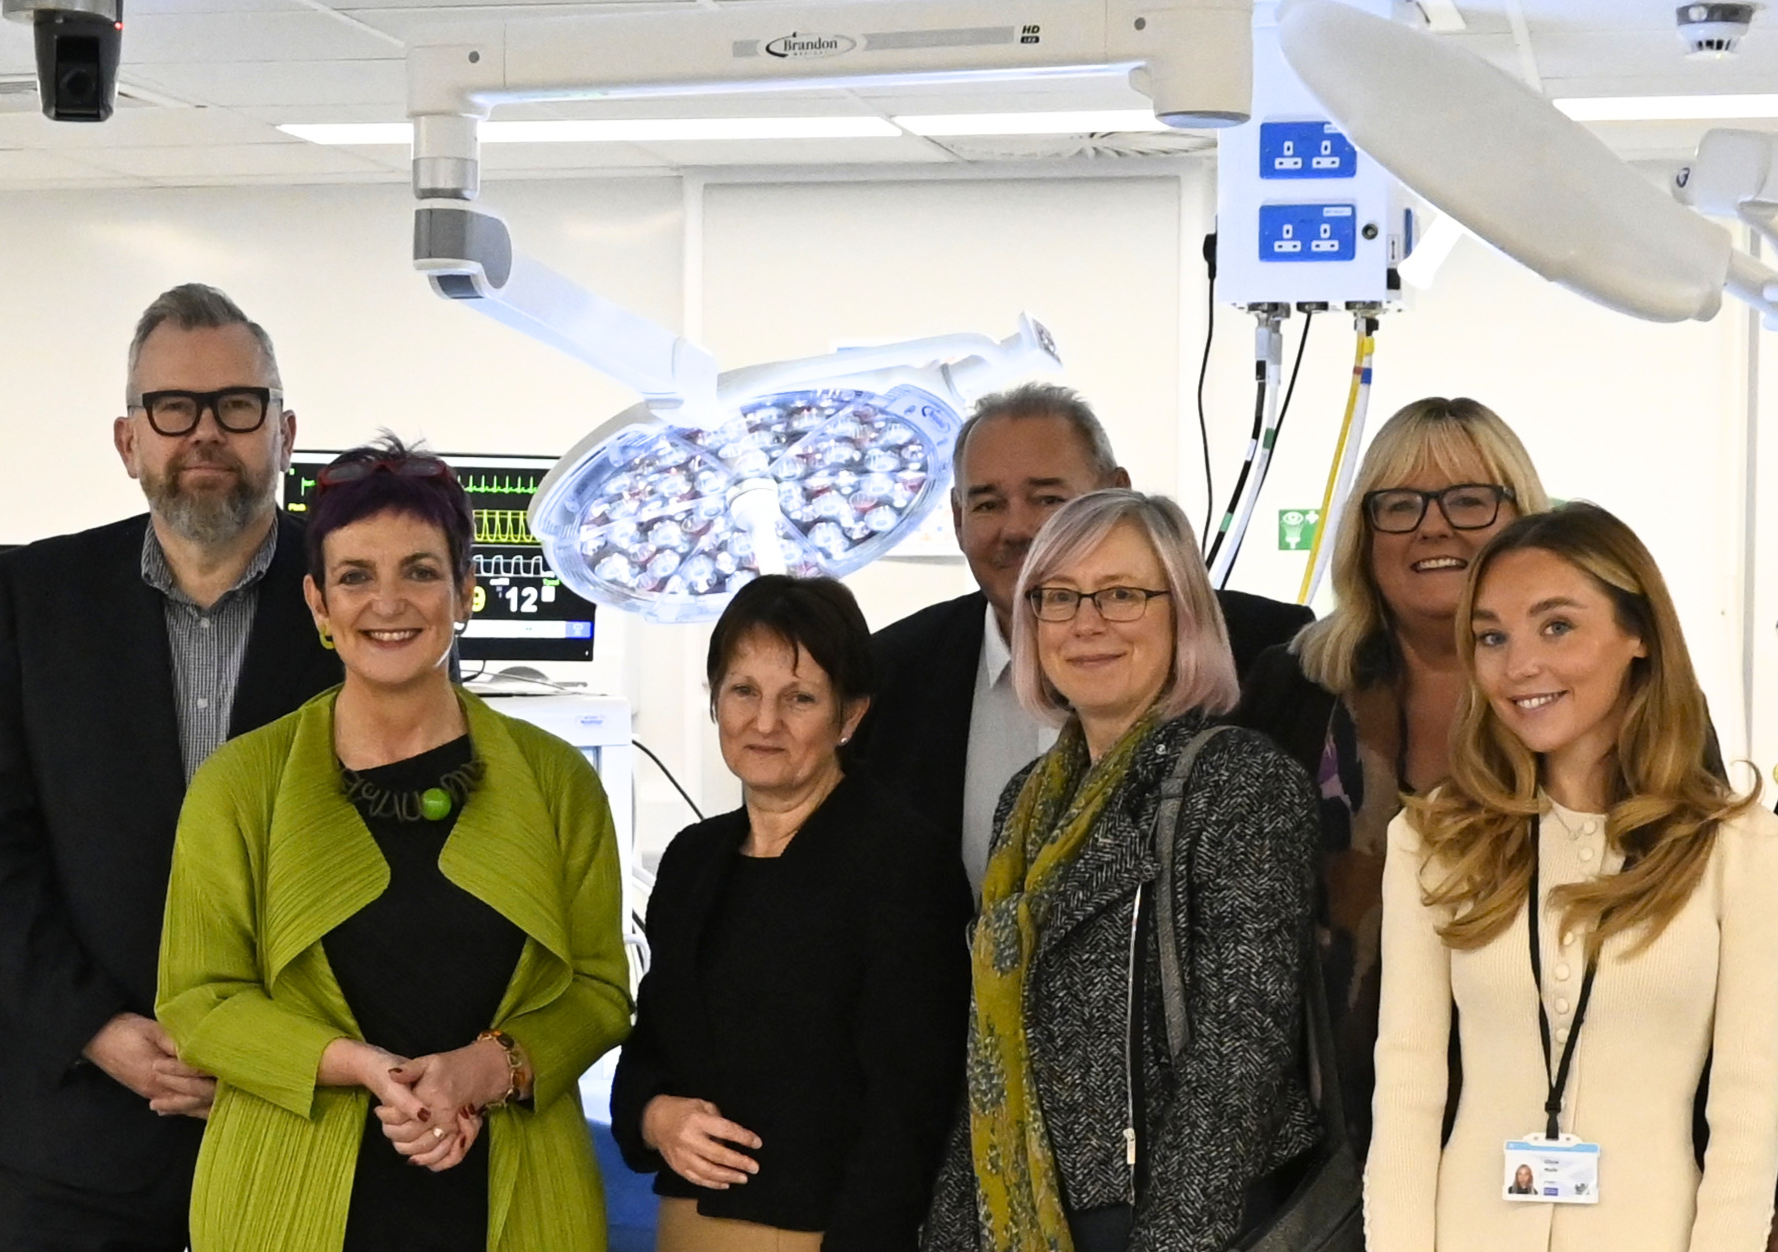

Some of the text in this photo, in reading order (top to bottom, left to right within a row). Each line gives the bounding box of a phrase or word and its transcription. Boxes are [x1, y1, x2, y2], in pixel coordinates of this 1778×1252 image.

[1022, 25, 1040, 34] HD
[784, 37, 838, 51] Brandon
[505, 586, 538, 612] 12
